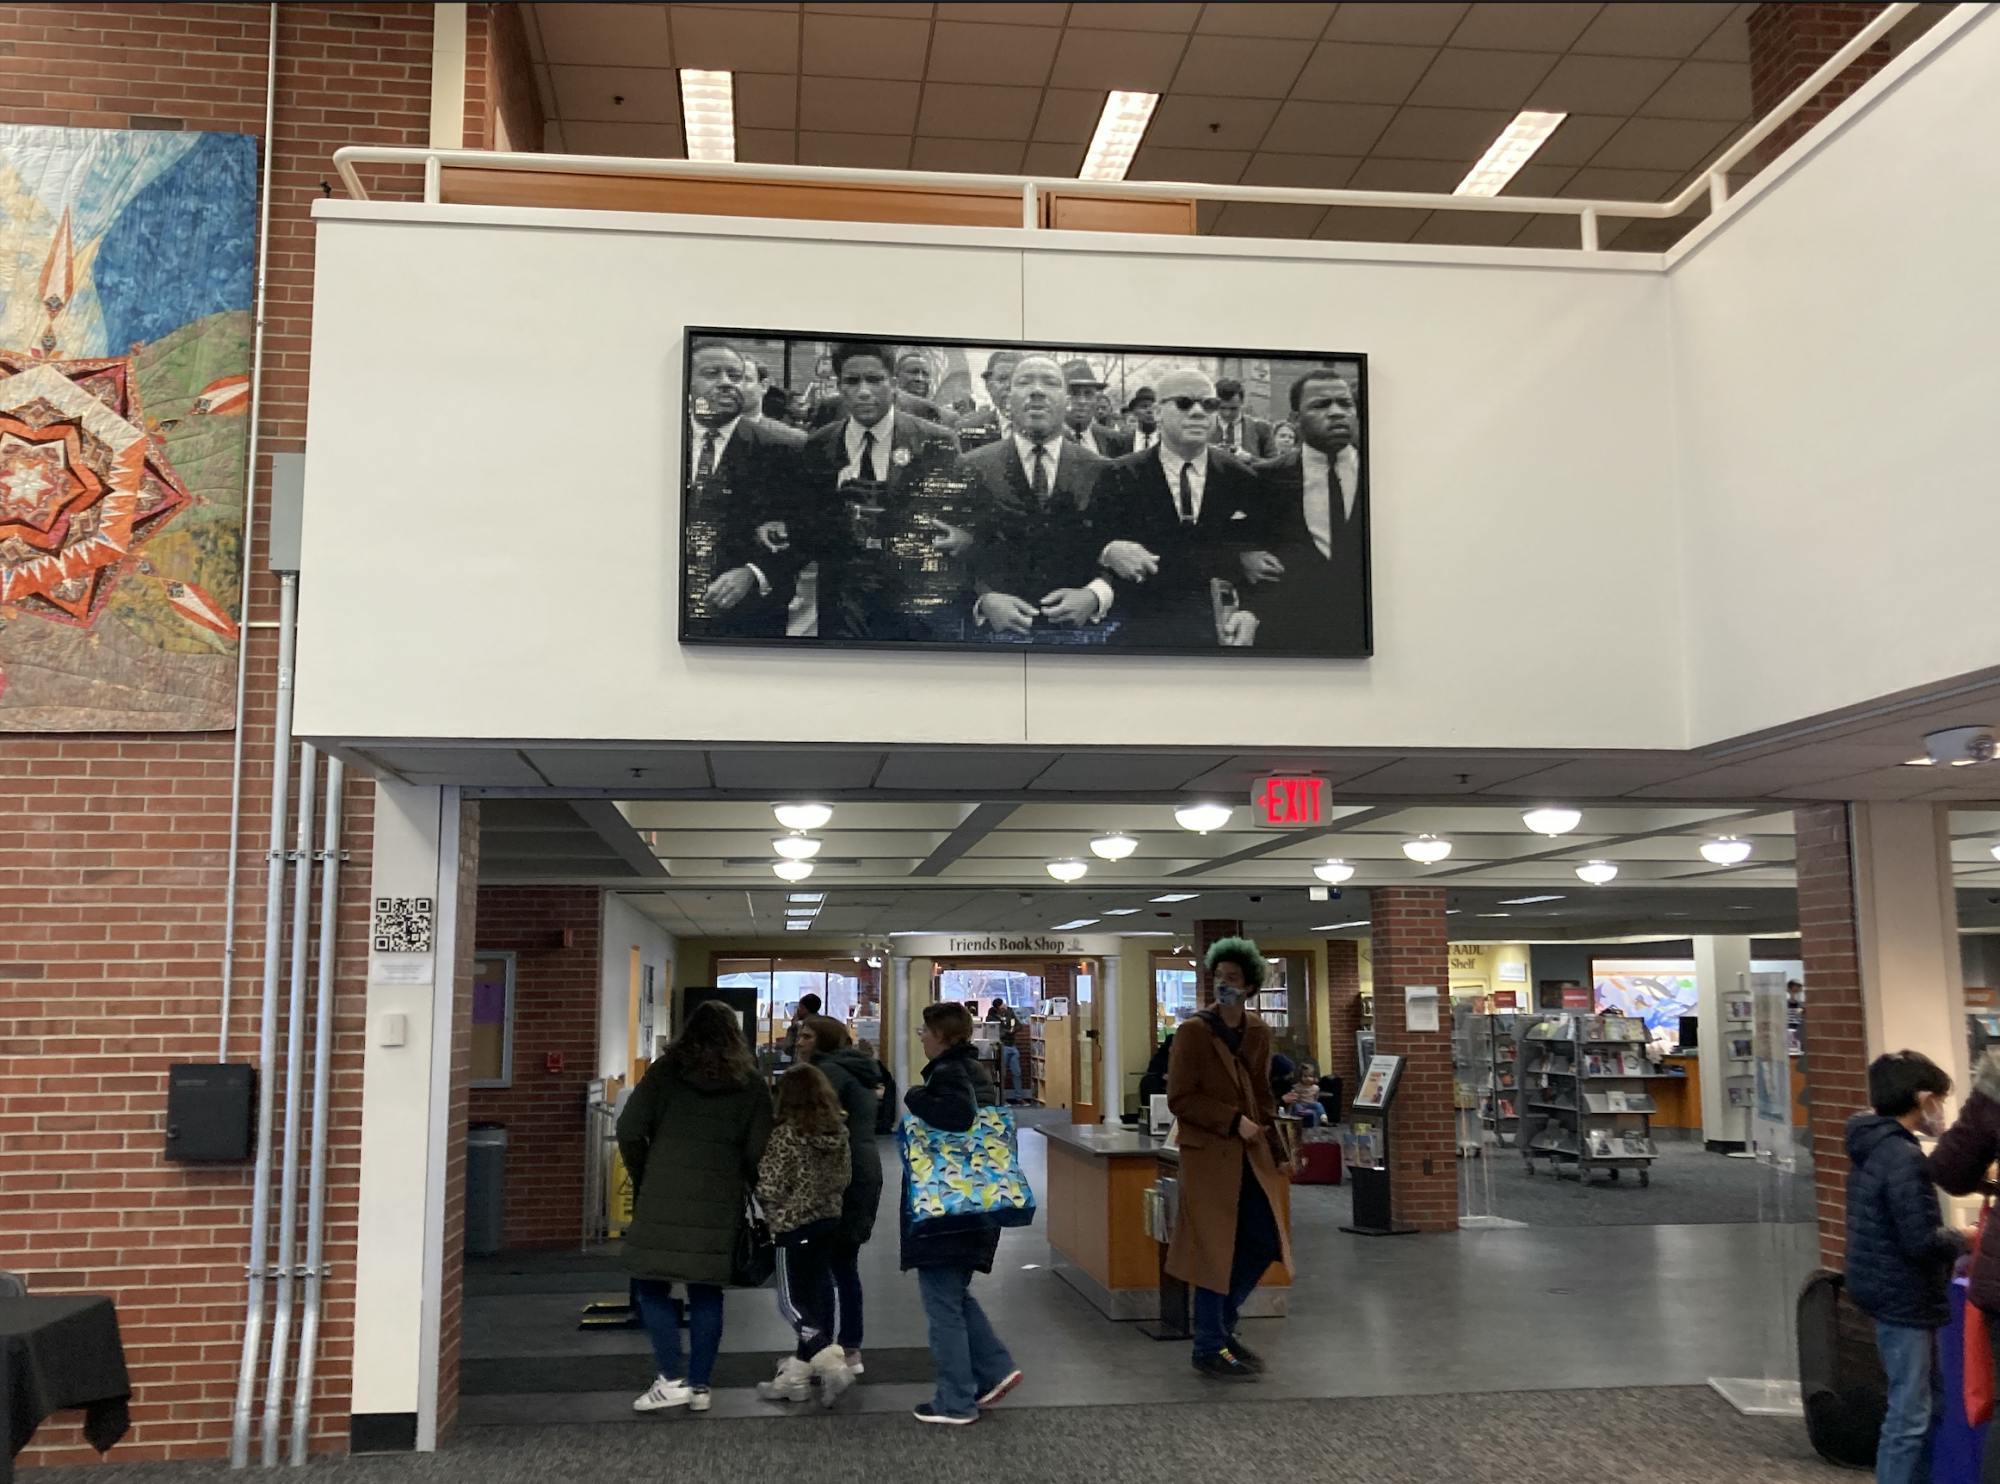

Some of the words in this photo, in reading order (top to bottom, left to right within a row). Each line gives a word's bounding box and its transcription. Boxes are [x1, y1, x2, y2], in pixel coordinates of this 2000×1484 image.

[1267, 778, 1323, 823] EXIT
[950, 937, 997, 952] Friends
[999, 937, 1033, 952] Book
[1034, 937, 1065, 954] Shop
[1451, 958, 1476, 969] Shelf
